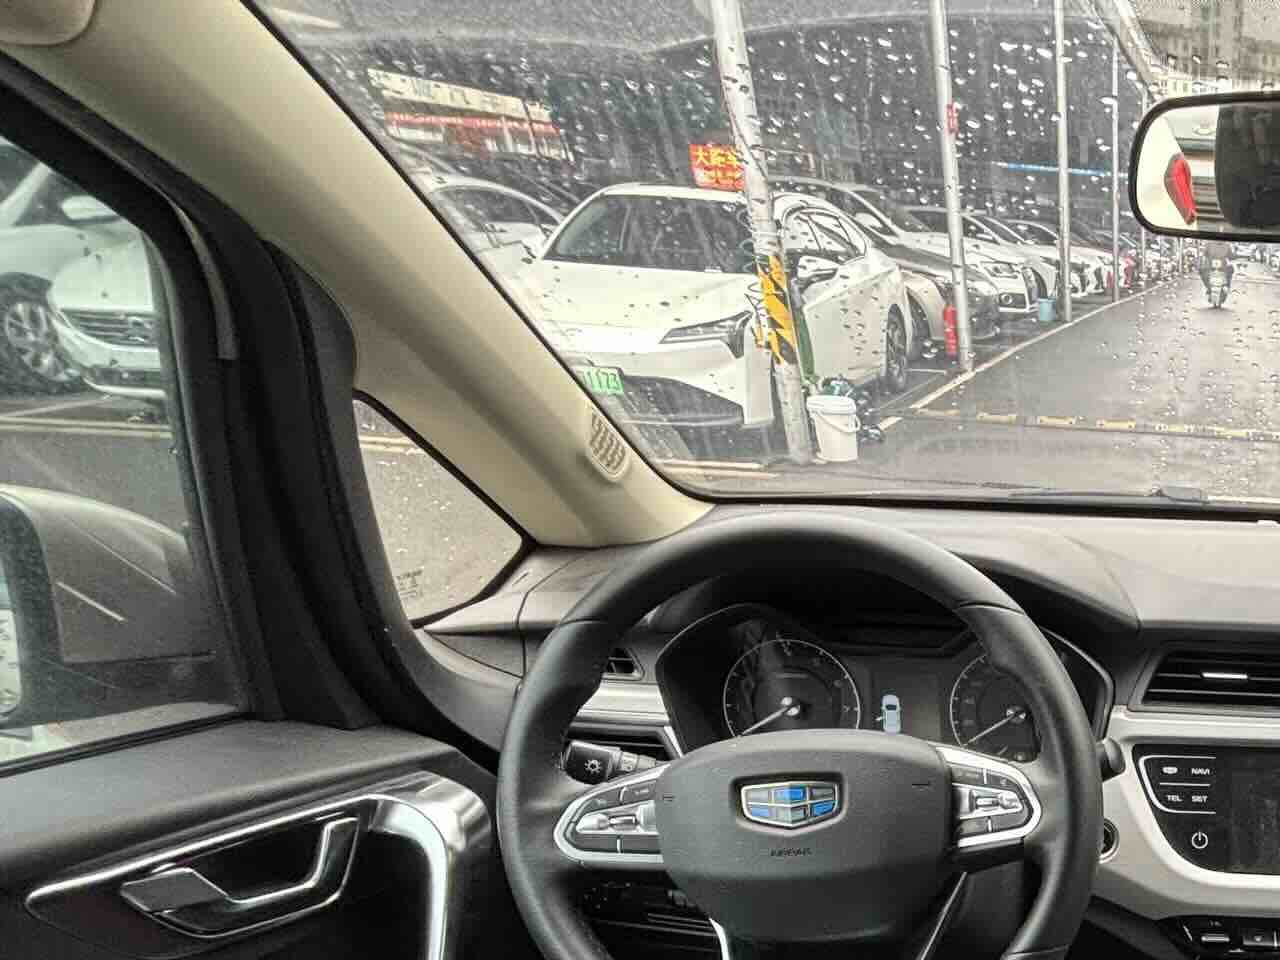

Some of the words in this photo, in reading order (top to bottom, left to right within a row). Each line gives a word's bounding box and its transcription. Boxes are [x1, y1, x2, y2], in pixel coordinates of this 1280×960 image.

[1190, 767, 1210, 775] NAVI
[1165, 794, 1183, 802] TEL
[1191, 795, 1208, 803] SET
